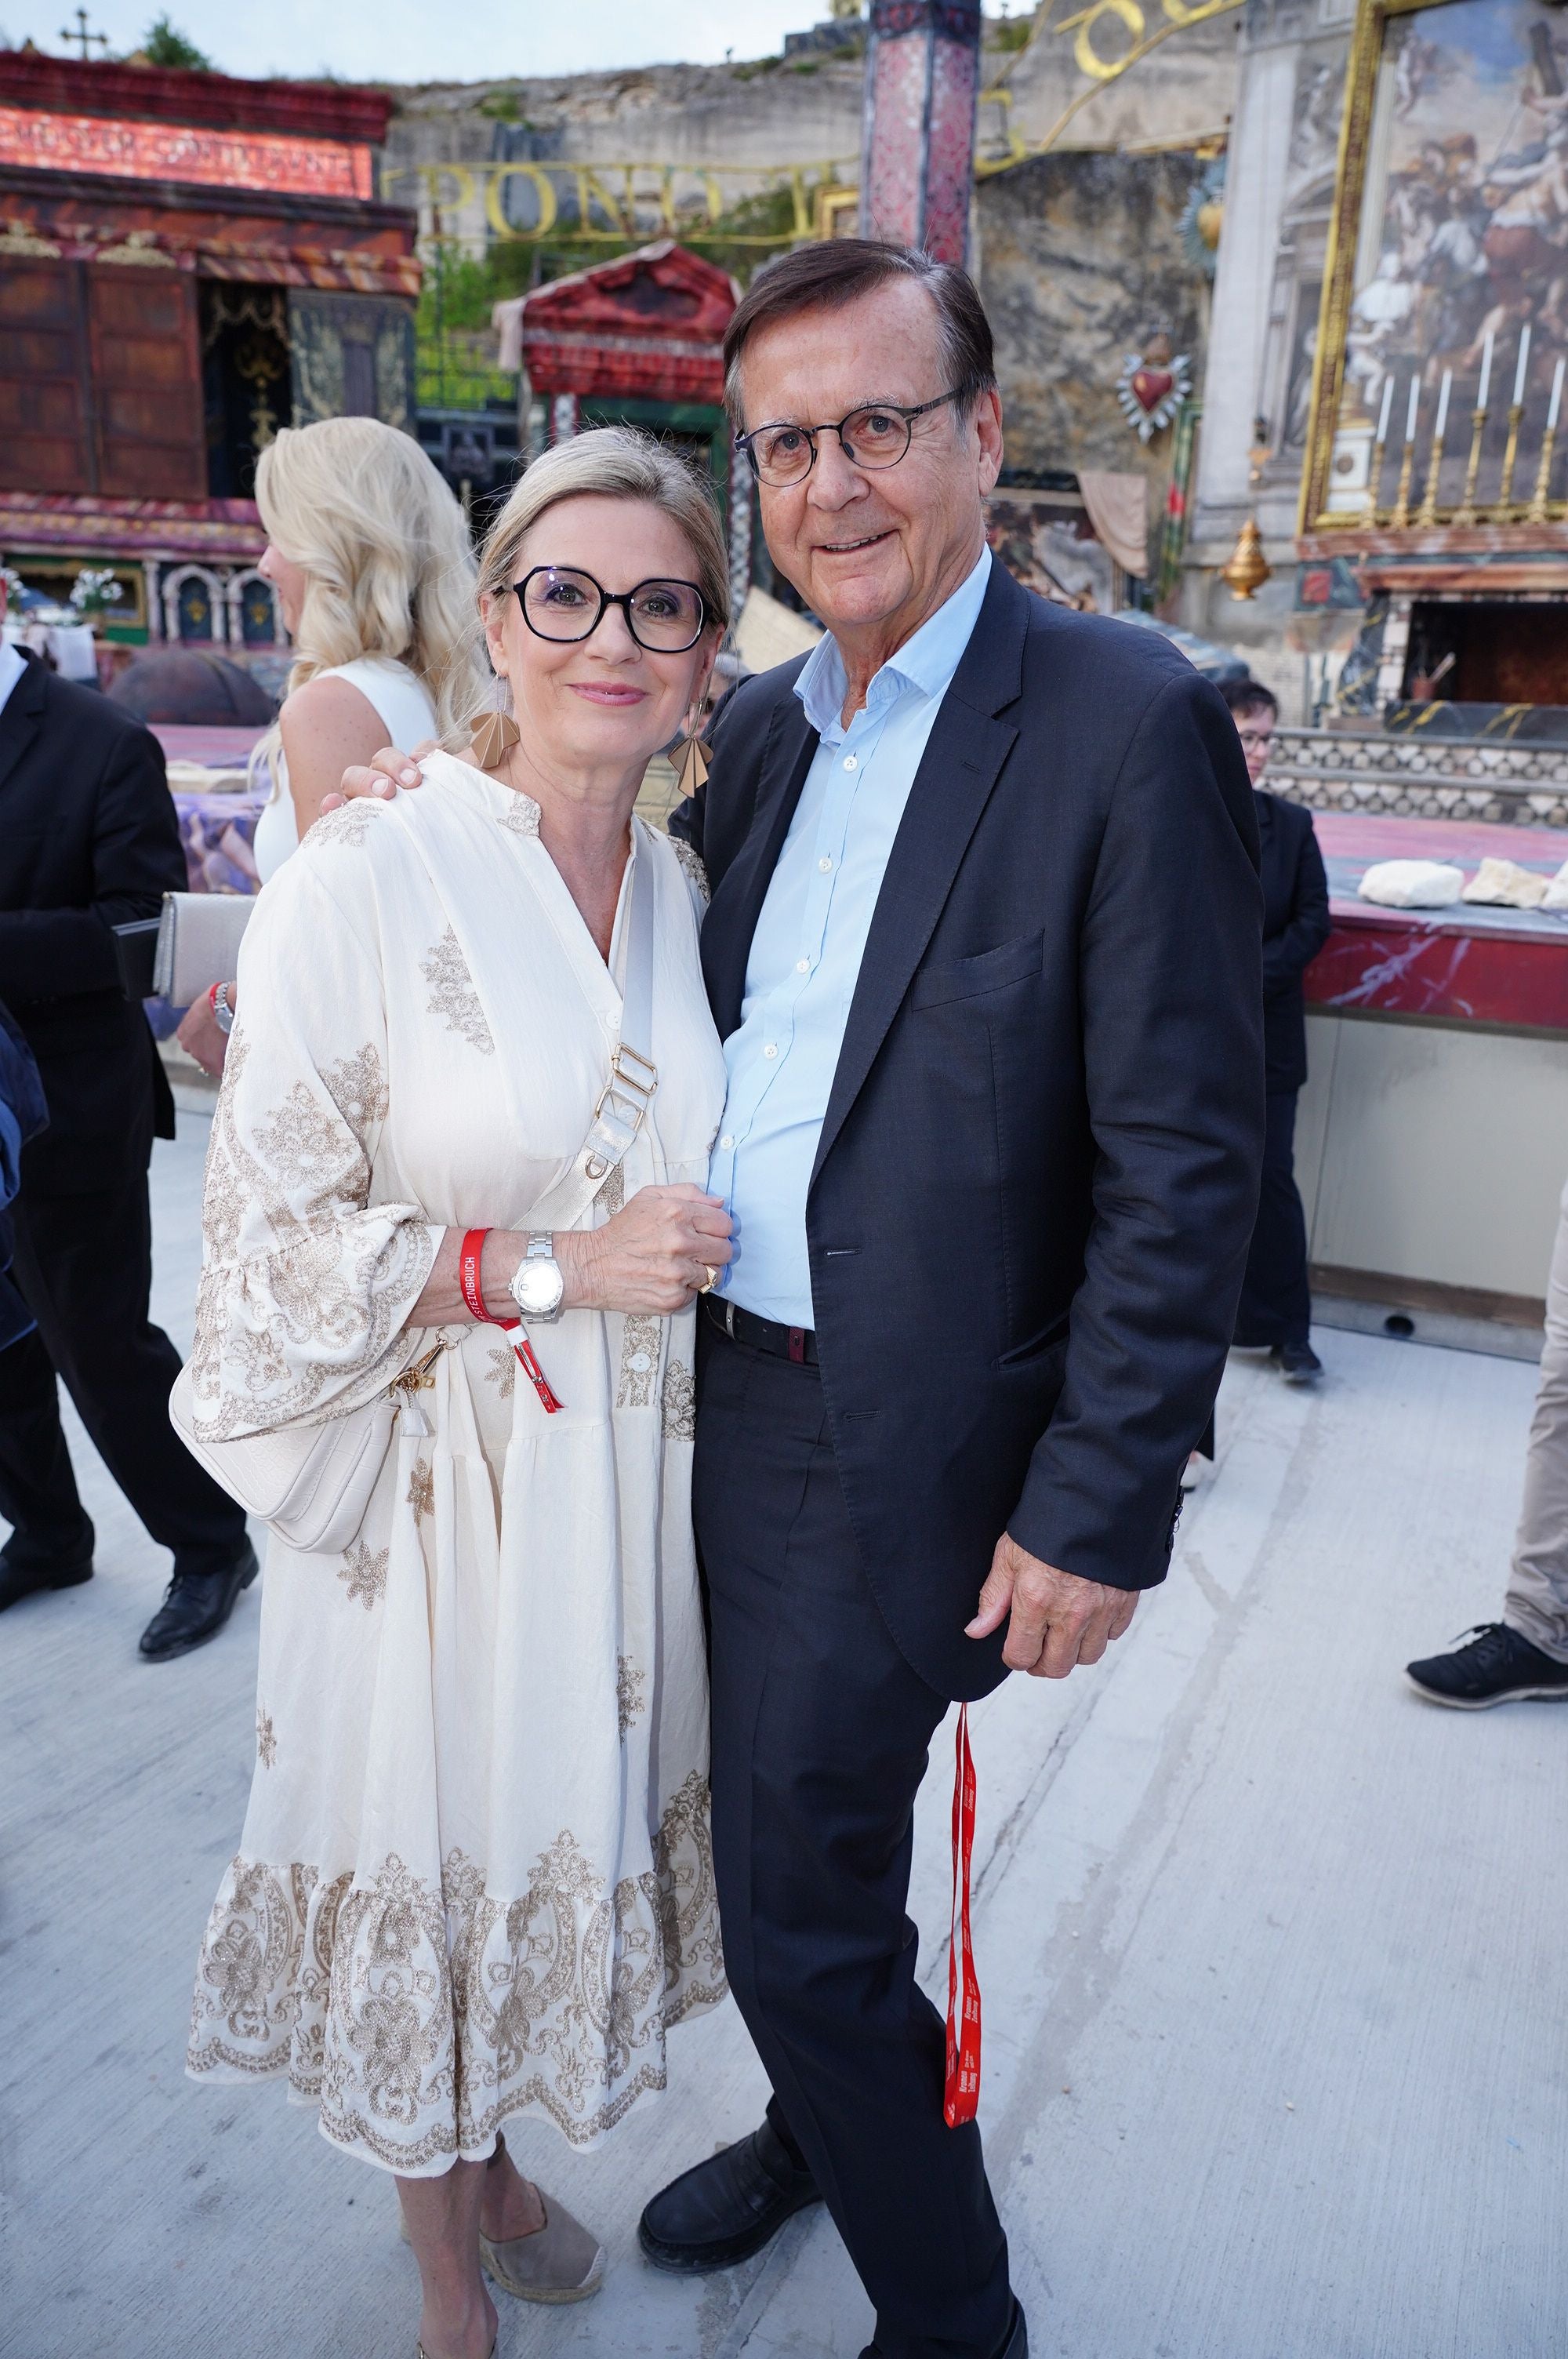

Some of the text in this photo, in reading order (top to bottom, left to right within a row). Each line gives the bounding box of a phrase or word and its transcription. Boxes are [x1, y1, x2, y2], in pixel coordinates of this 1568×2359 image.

[465, 1257, 483, 1315] STEINBRUCH
[959, 2070, 967, 2093] Kronen
[968, 2072, 978, 2093] Zeitung
